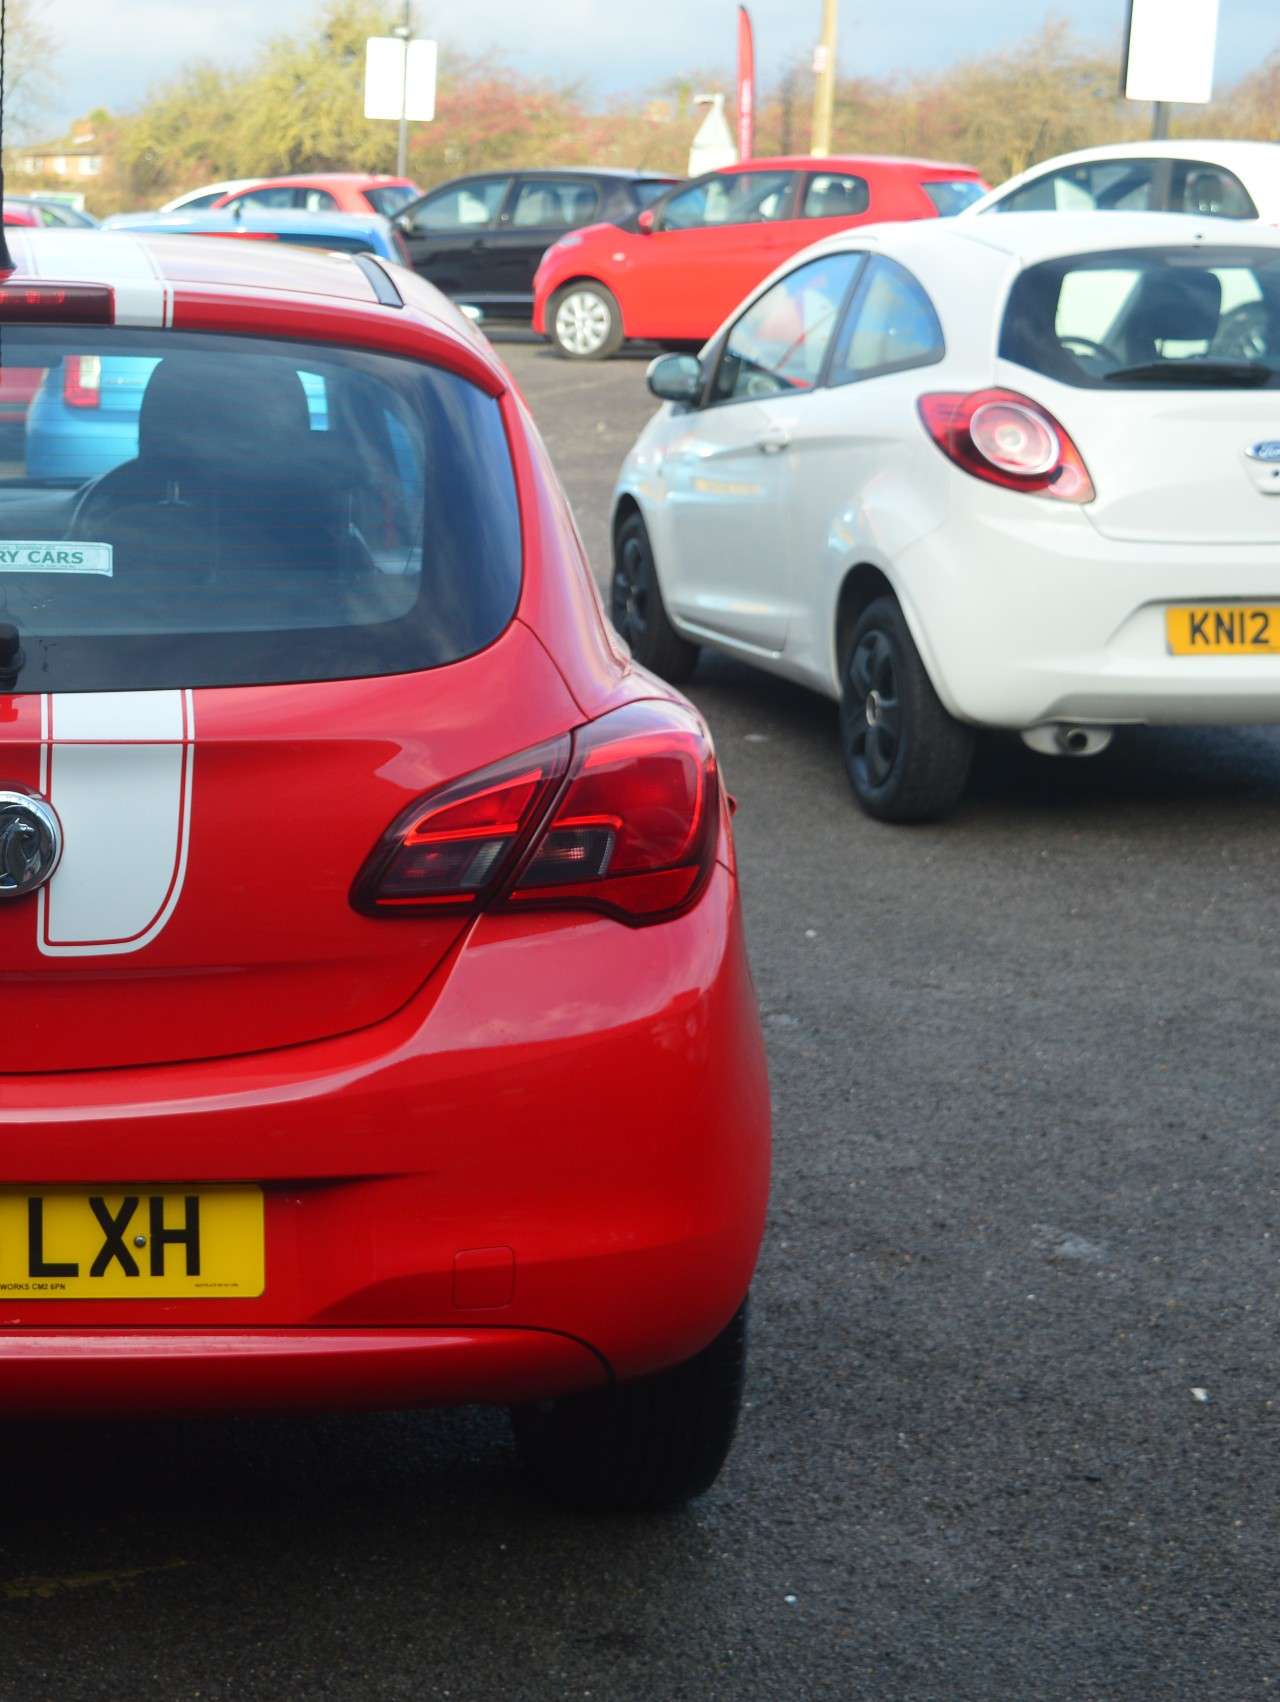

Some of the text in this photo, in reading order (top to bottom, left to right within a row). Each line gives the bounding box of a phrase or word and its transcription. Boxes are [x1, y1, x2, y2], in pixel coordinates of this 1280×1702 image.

[27, 550, 85, 564] CARS
[1189, 610, 1270, 645] KN12
[28, 1195, 201, 1277] LXH
